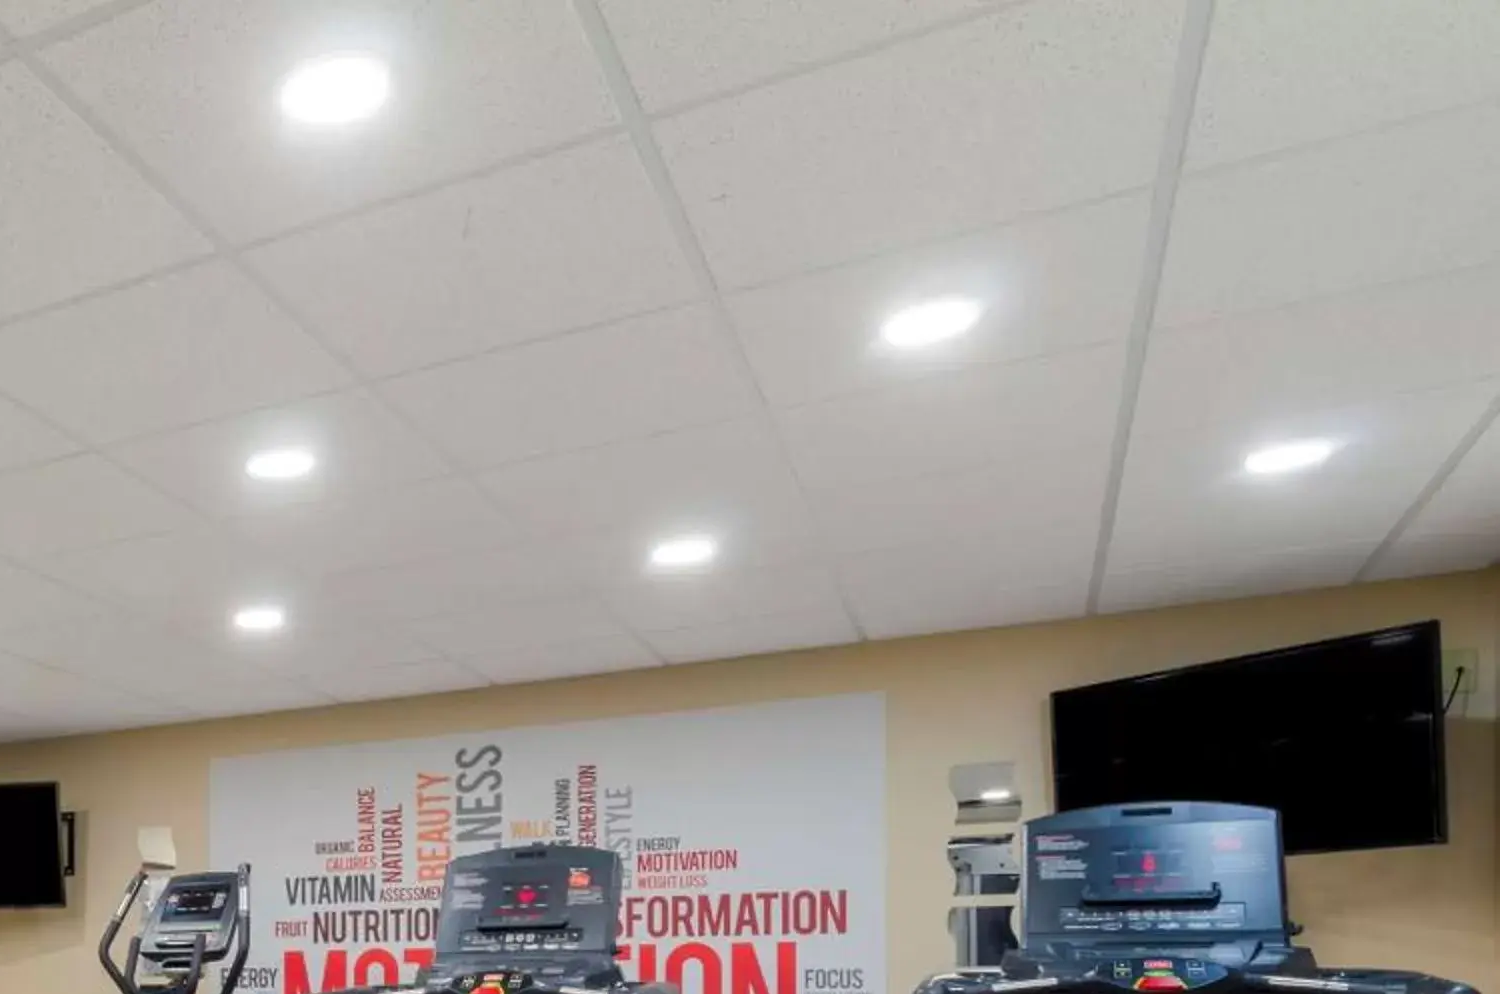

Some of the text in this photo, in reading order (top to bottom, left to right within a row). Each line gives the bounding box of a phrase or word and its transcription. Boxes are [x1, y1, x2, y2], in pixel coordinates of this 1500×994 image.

[456, 744, 504, 844] NESS
[357, 786, 376, 853] BALANCE
[416, 771, 452, 882] BEAUTY
[381, 803, 403, 883] NATURAL
[636, 837, 681, 851] ENERGY
[636, 849, 738, 873] MOTIVATION
[285, 873, 375, 905] VITAMIN
[275, 921, 308, 938] FRUIT
[220, 966, 278, 989] EERGY
[804, 969, 864, 990] FOCUS
